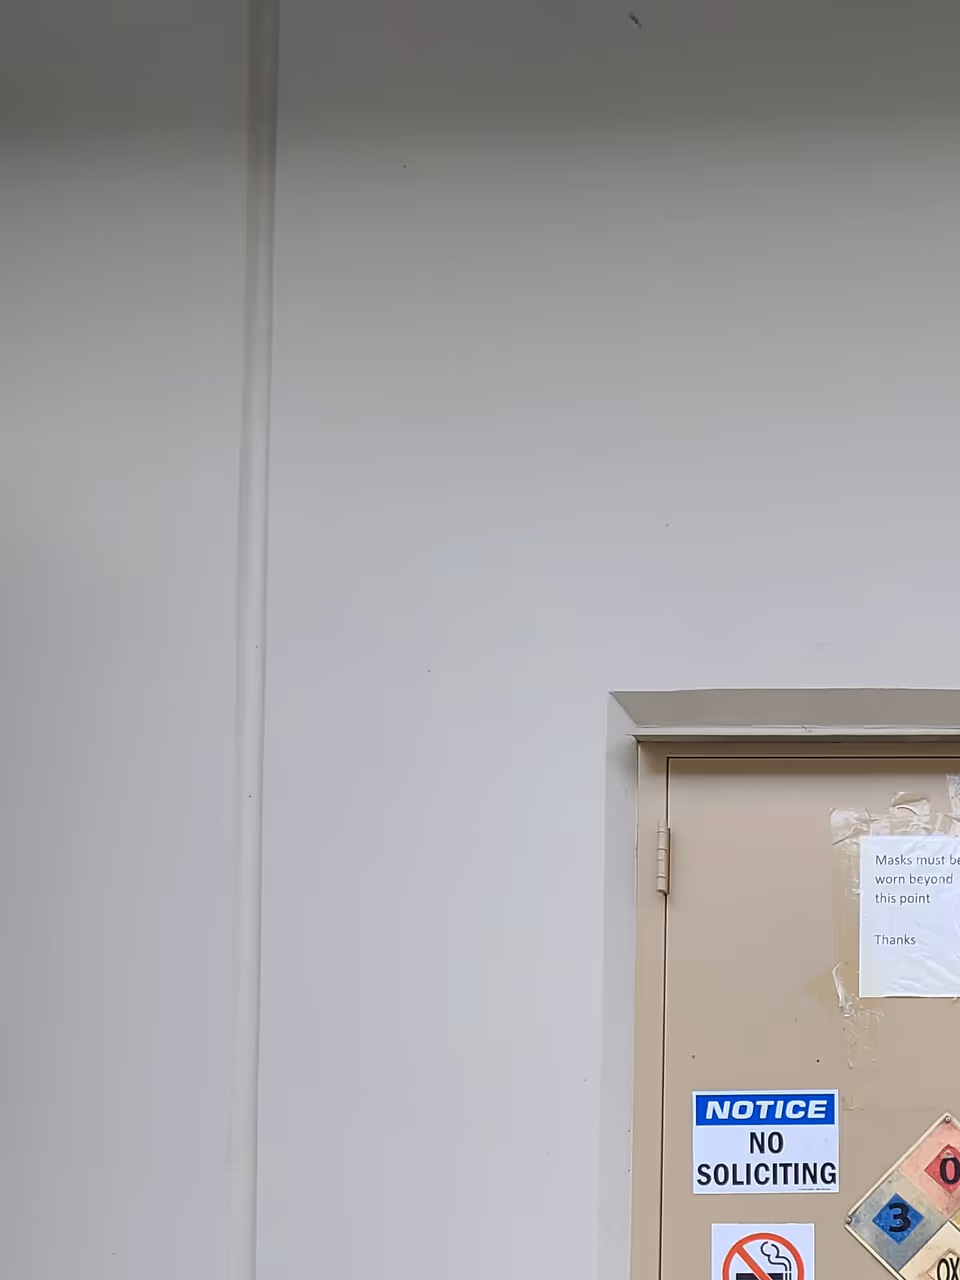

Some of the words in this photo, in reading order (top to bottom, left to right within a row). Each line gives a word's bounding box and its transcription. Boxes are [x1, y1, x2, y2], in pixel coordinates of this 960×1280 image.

[875, 854, 913, 866] Masks
[916, 855, 945, 866] must
[875, 876, 905, 886] worn
[909, 873, 953, 887] beyond
[875, 892, 897, 904] this
[900, 893, 931, 906] point
[874, 933, 916, 945] Thanks
[705, 1100, 828, 1120] NOTICE
[749, 1131, 784, 1154] NO
[696, 1162, 837, 1186] SOLICITING
[888, 1202, 912, 1233] 3
